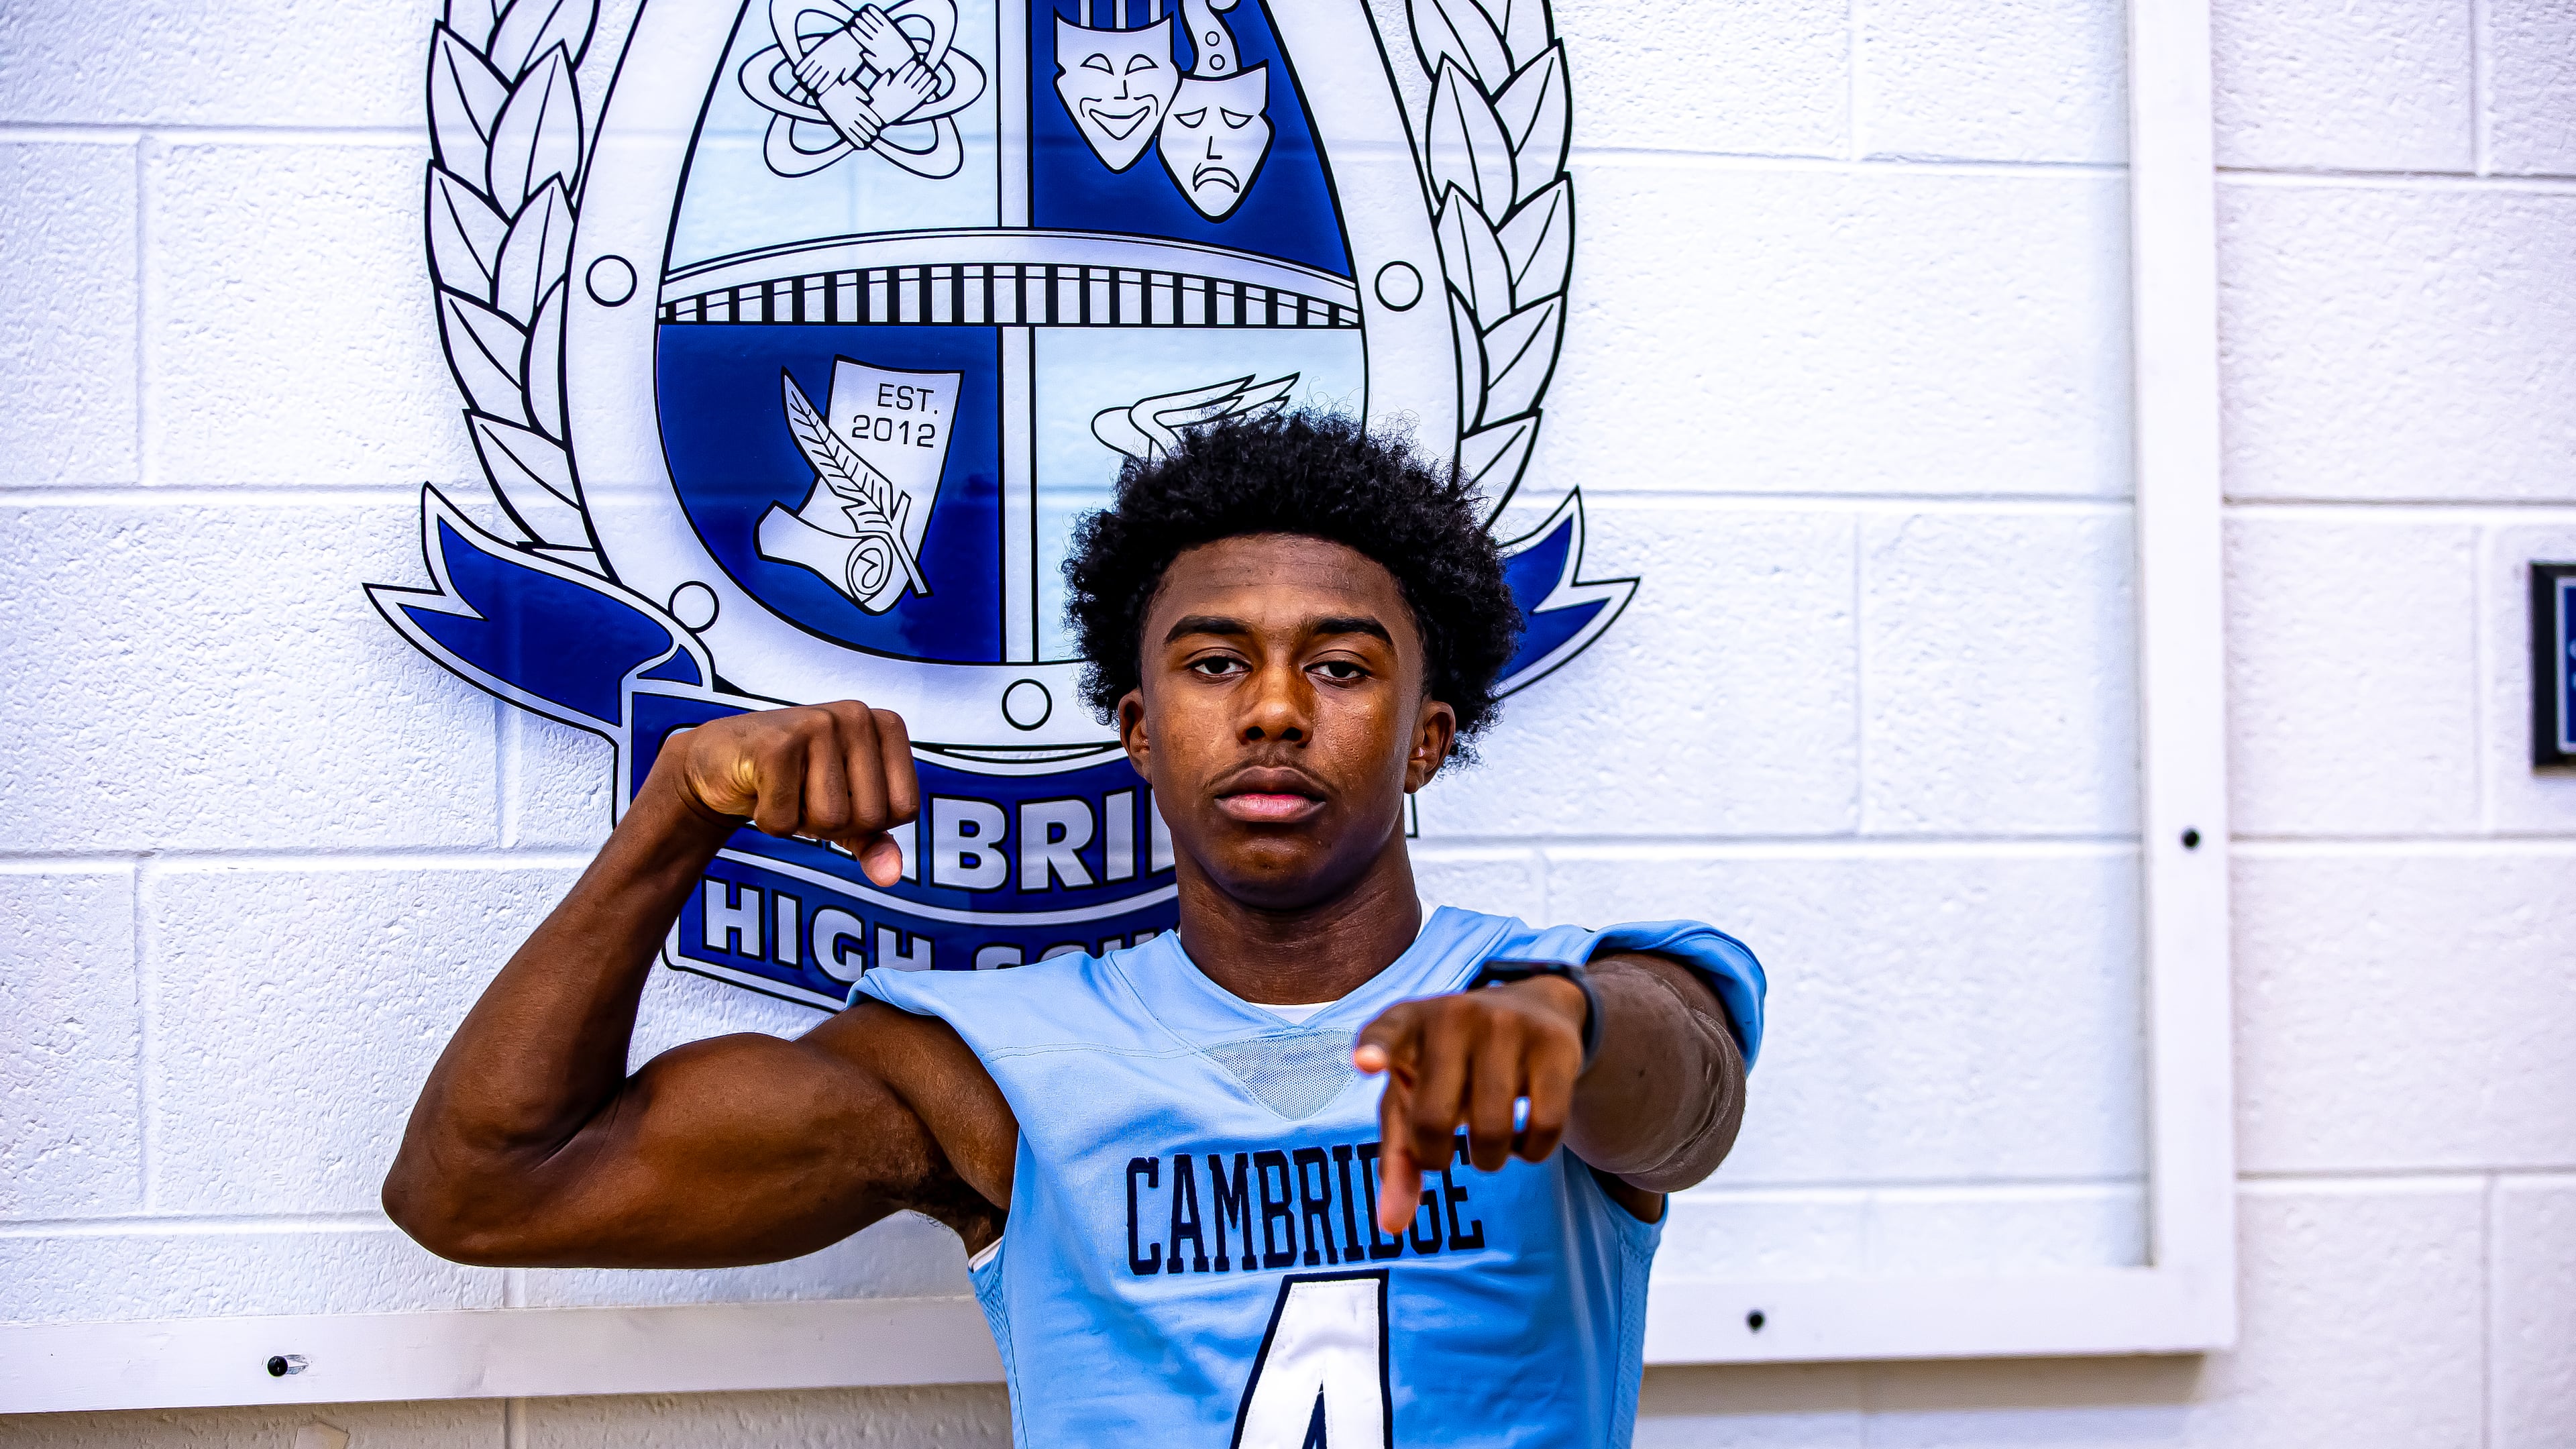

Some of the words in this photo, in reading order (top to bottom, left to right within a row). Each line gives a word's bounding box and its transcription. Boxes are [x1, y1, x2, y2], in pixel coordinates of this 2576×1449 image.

[877, 382, 938, 415] EST.
[851, 414, 936, 448] 2012
[704, 878, 933, 983] HIGH
